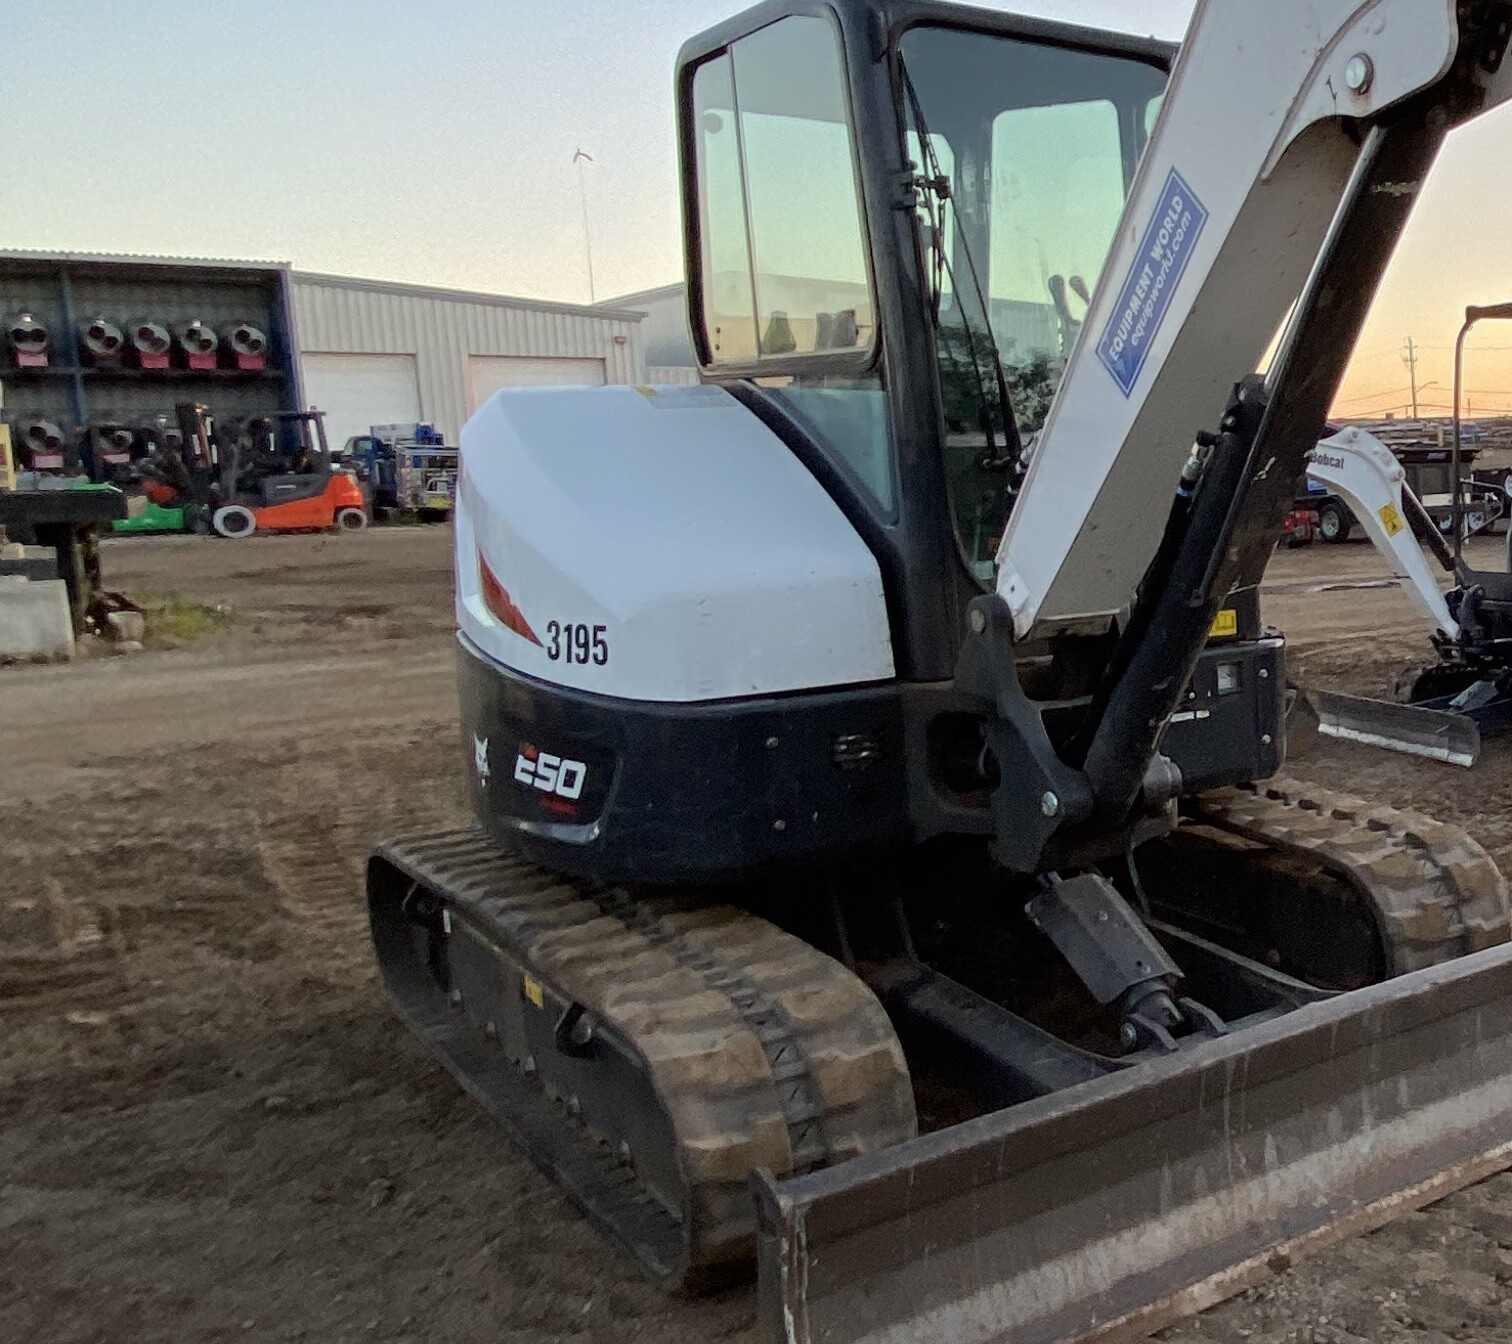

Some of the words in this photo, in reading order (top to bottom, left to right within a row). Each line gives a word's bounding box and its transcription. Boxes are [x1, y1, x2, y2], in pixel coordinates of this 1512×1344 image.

[1108, 262, 1155, 361] EQUIPMENT
[1150, 195, 1184, 262] WORLD
[1131, 211, 1192, 347] equipworld.com
[1309, 452, 1344, 469] Bobcat
[547, 620, 608, 666] 3195
[514, 745, 587, 799] E50
